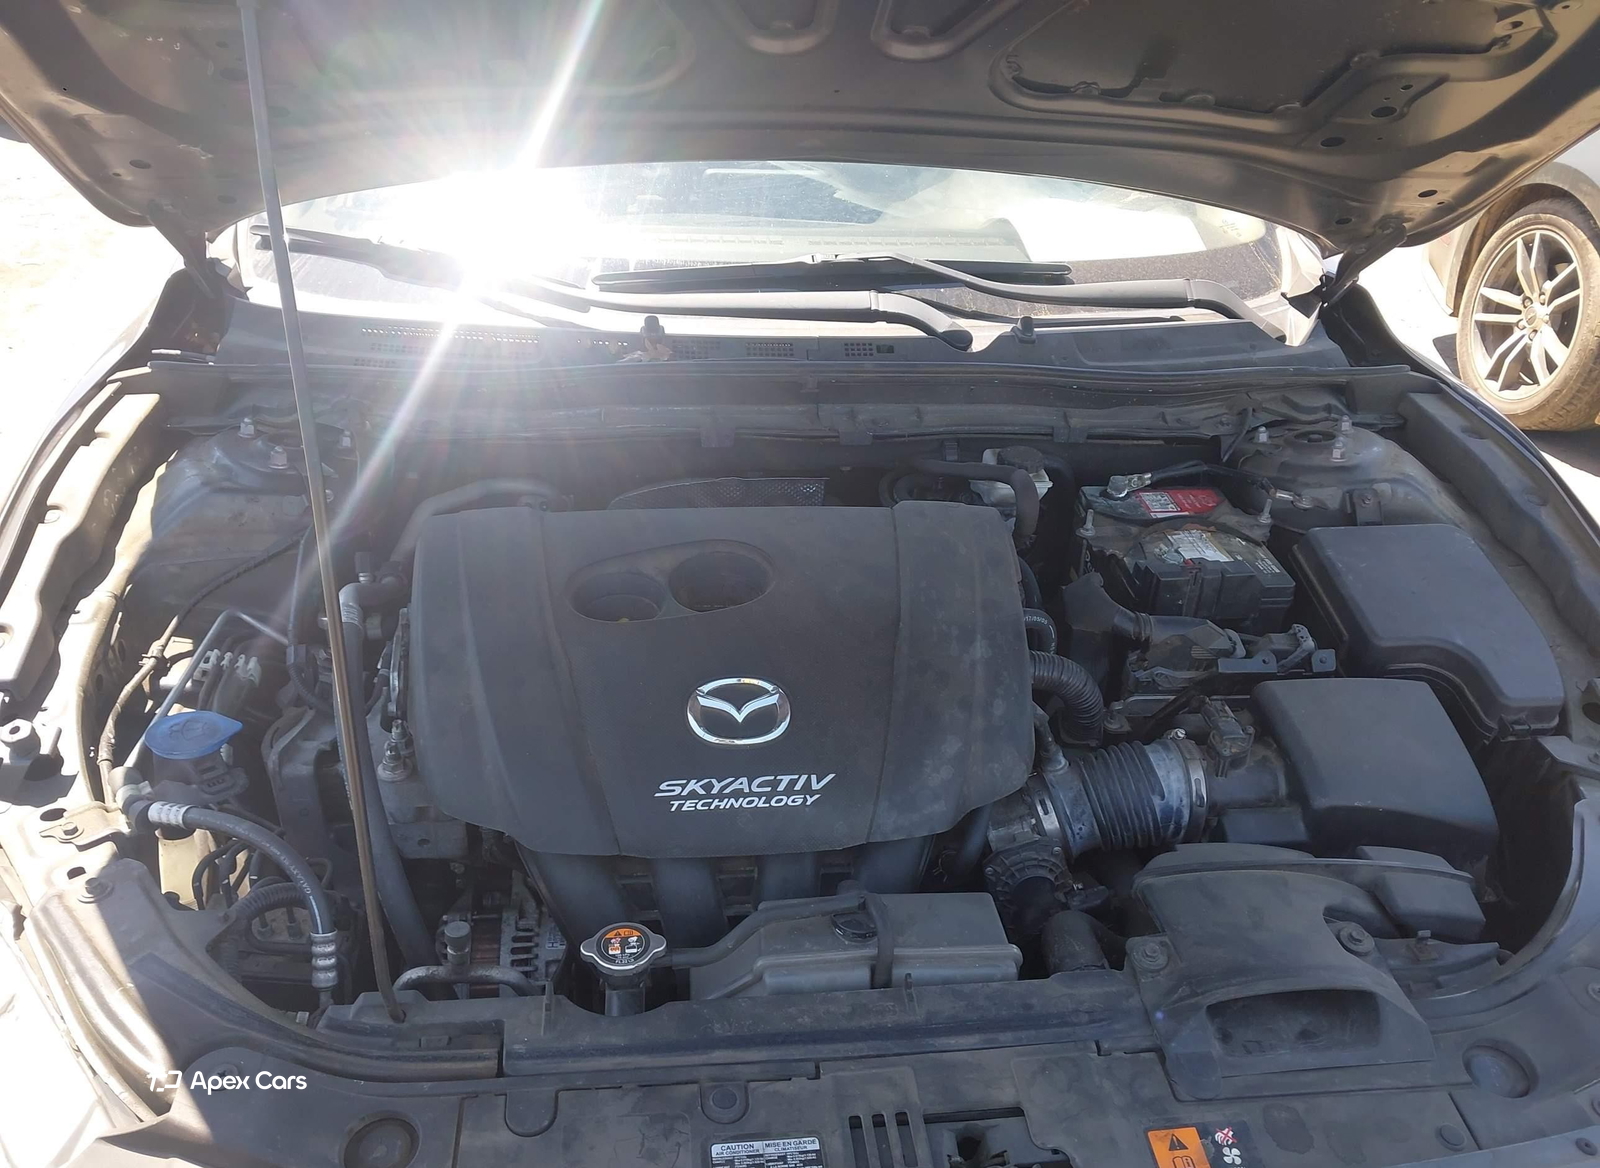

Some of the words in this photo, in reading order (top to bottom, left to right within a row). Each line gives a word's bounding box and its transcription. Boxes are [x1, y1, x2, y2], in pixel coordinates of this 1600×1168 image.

[654, 773, 836, 797] SKYACTIV
[669, 794, 821, 812] TECHNOLOGY
[720, 1143, 754, 1151] CAUTION
[793, 1138, 817, 1146] GARDE
